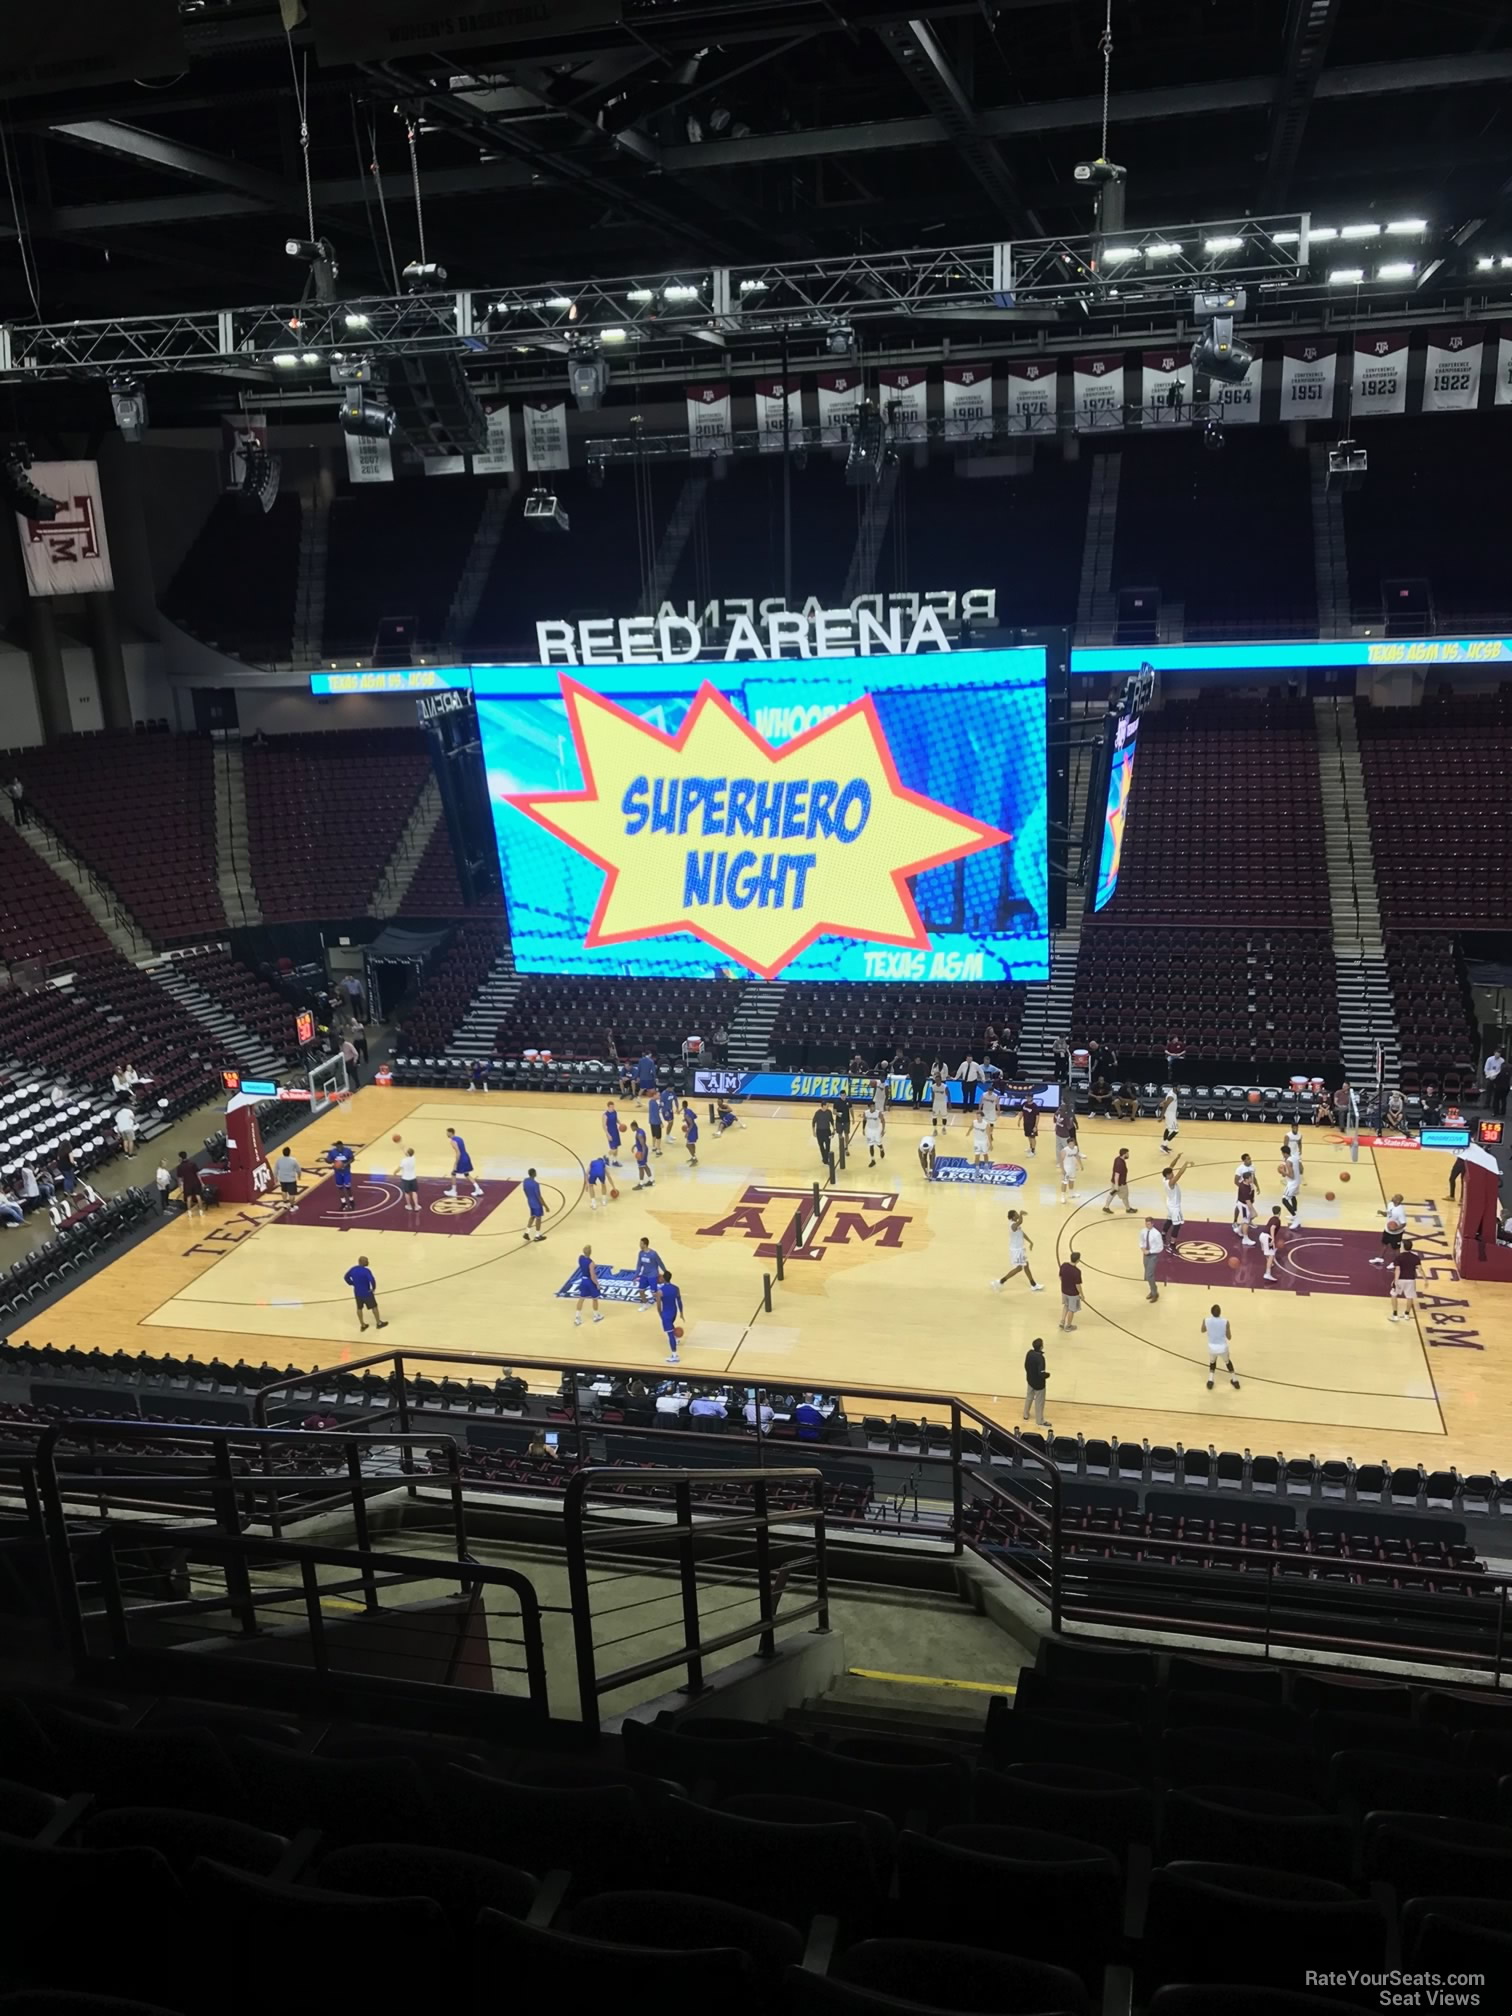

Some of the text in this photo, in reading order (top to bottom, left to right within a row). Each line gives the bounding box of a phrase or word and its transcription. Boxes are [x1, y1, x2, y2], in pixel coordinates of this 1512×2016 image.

[1361, 379, 1397, 396] 1923
[1433, 375, 1470, 391] 1922
[1218, 389, 1252, 404] 1964
[1291, 385, 1323, 400] 1951
[536, 605, 952, 666] REED ARENA
[1369, 643, 1405, 662] TEXAS
[621, 775, 873, 844] SUPERHERO
[683, 850, 817, 911] NIGHT
[863, 951, 985, 980] TEXAS A&M
[1484, 1131, 1498, 1140] 30
[937, 1171, 1017, 1183] LEGENDS
[1415, 1291, 1485, 1350] A&M
